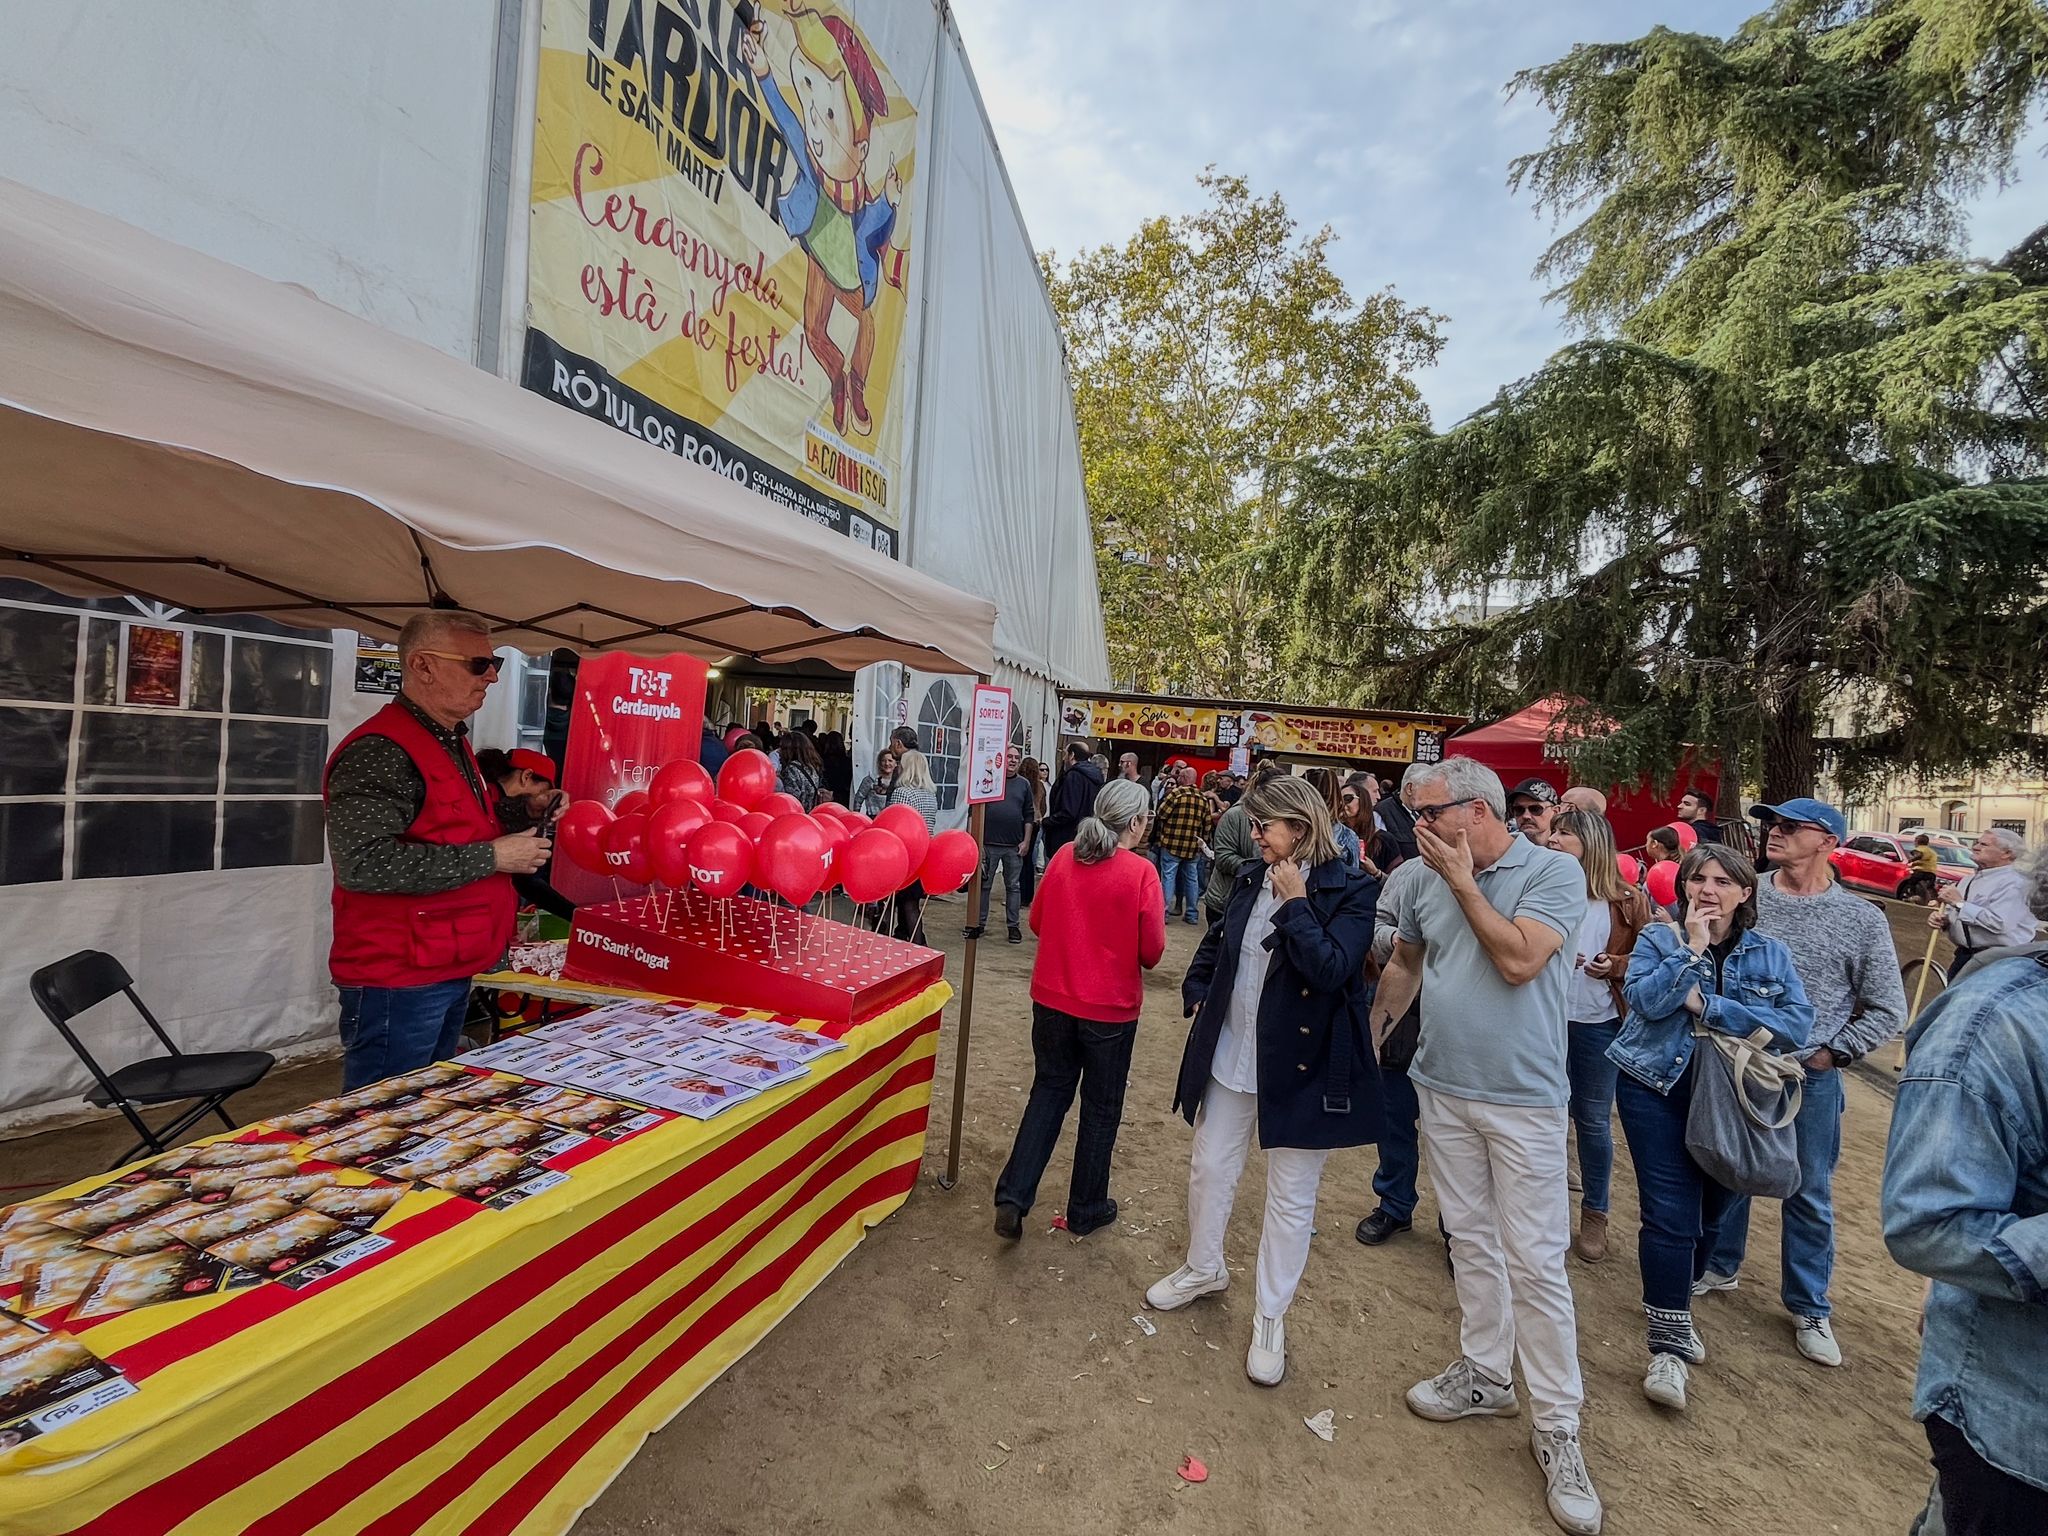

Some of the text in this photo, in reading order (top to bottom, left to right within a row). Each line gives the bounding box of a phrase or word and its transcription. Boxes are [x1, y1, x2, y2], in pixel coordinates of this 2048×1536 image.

[586, 48, 615, 106] DE
[580, 257, 805, 392] està de festa!
[682, 433, 748, 486] ROMO
[798, 494, 807, 506] EN
[807, 499, 816, 511] LA
[612, 695, 681, 721] Cerdanyola
[1137, 707, 1170, 726] Som
[1284, 718, 1355, 732] COMISSIÓ
[1300, 730, 1377, 745] DE FESTES
[1316, 742, 1408, 759] SANT MARTÍ
[604, 851, 631, 865] TOT
[688, 864, 724, 884] TOT
[576, 928, 670, 970] TOT Sant Cugat
